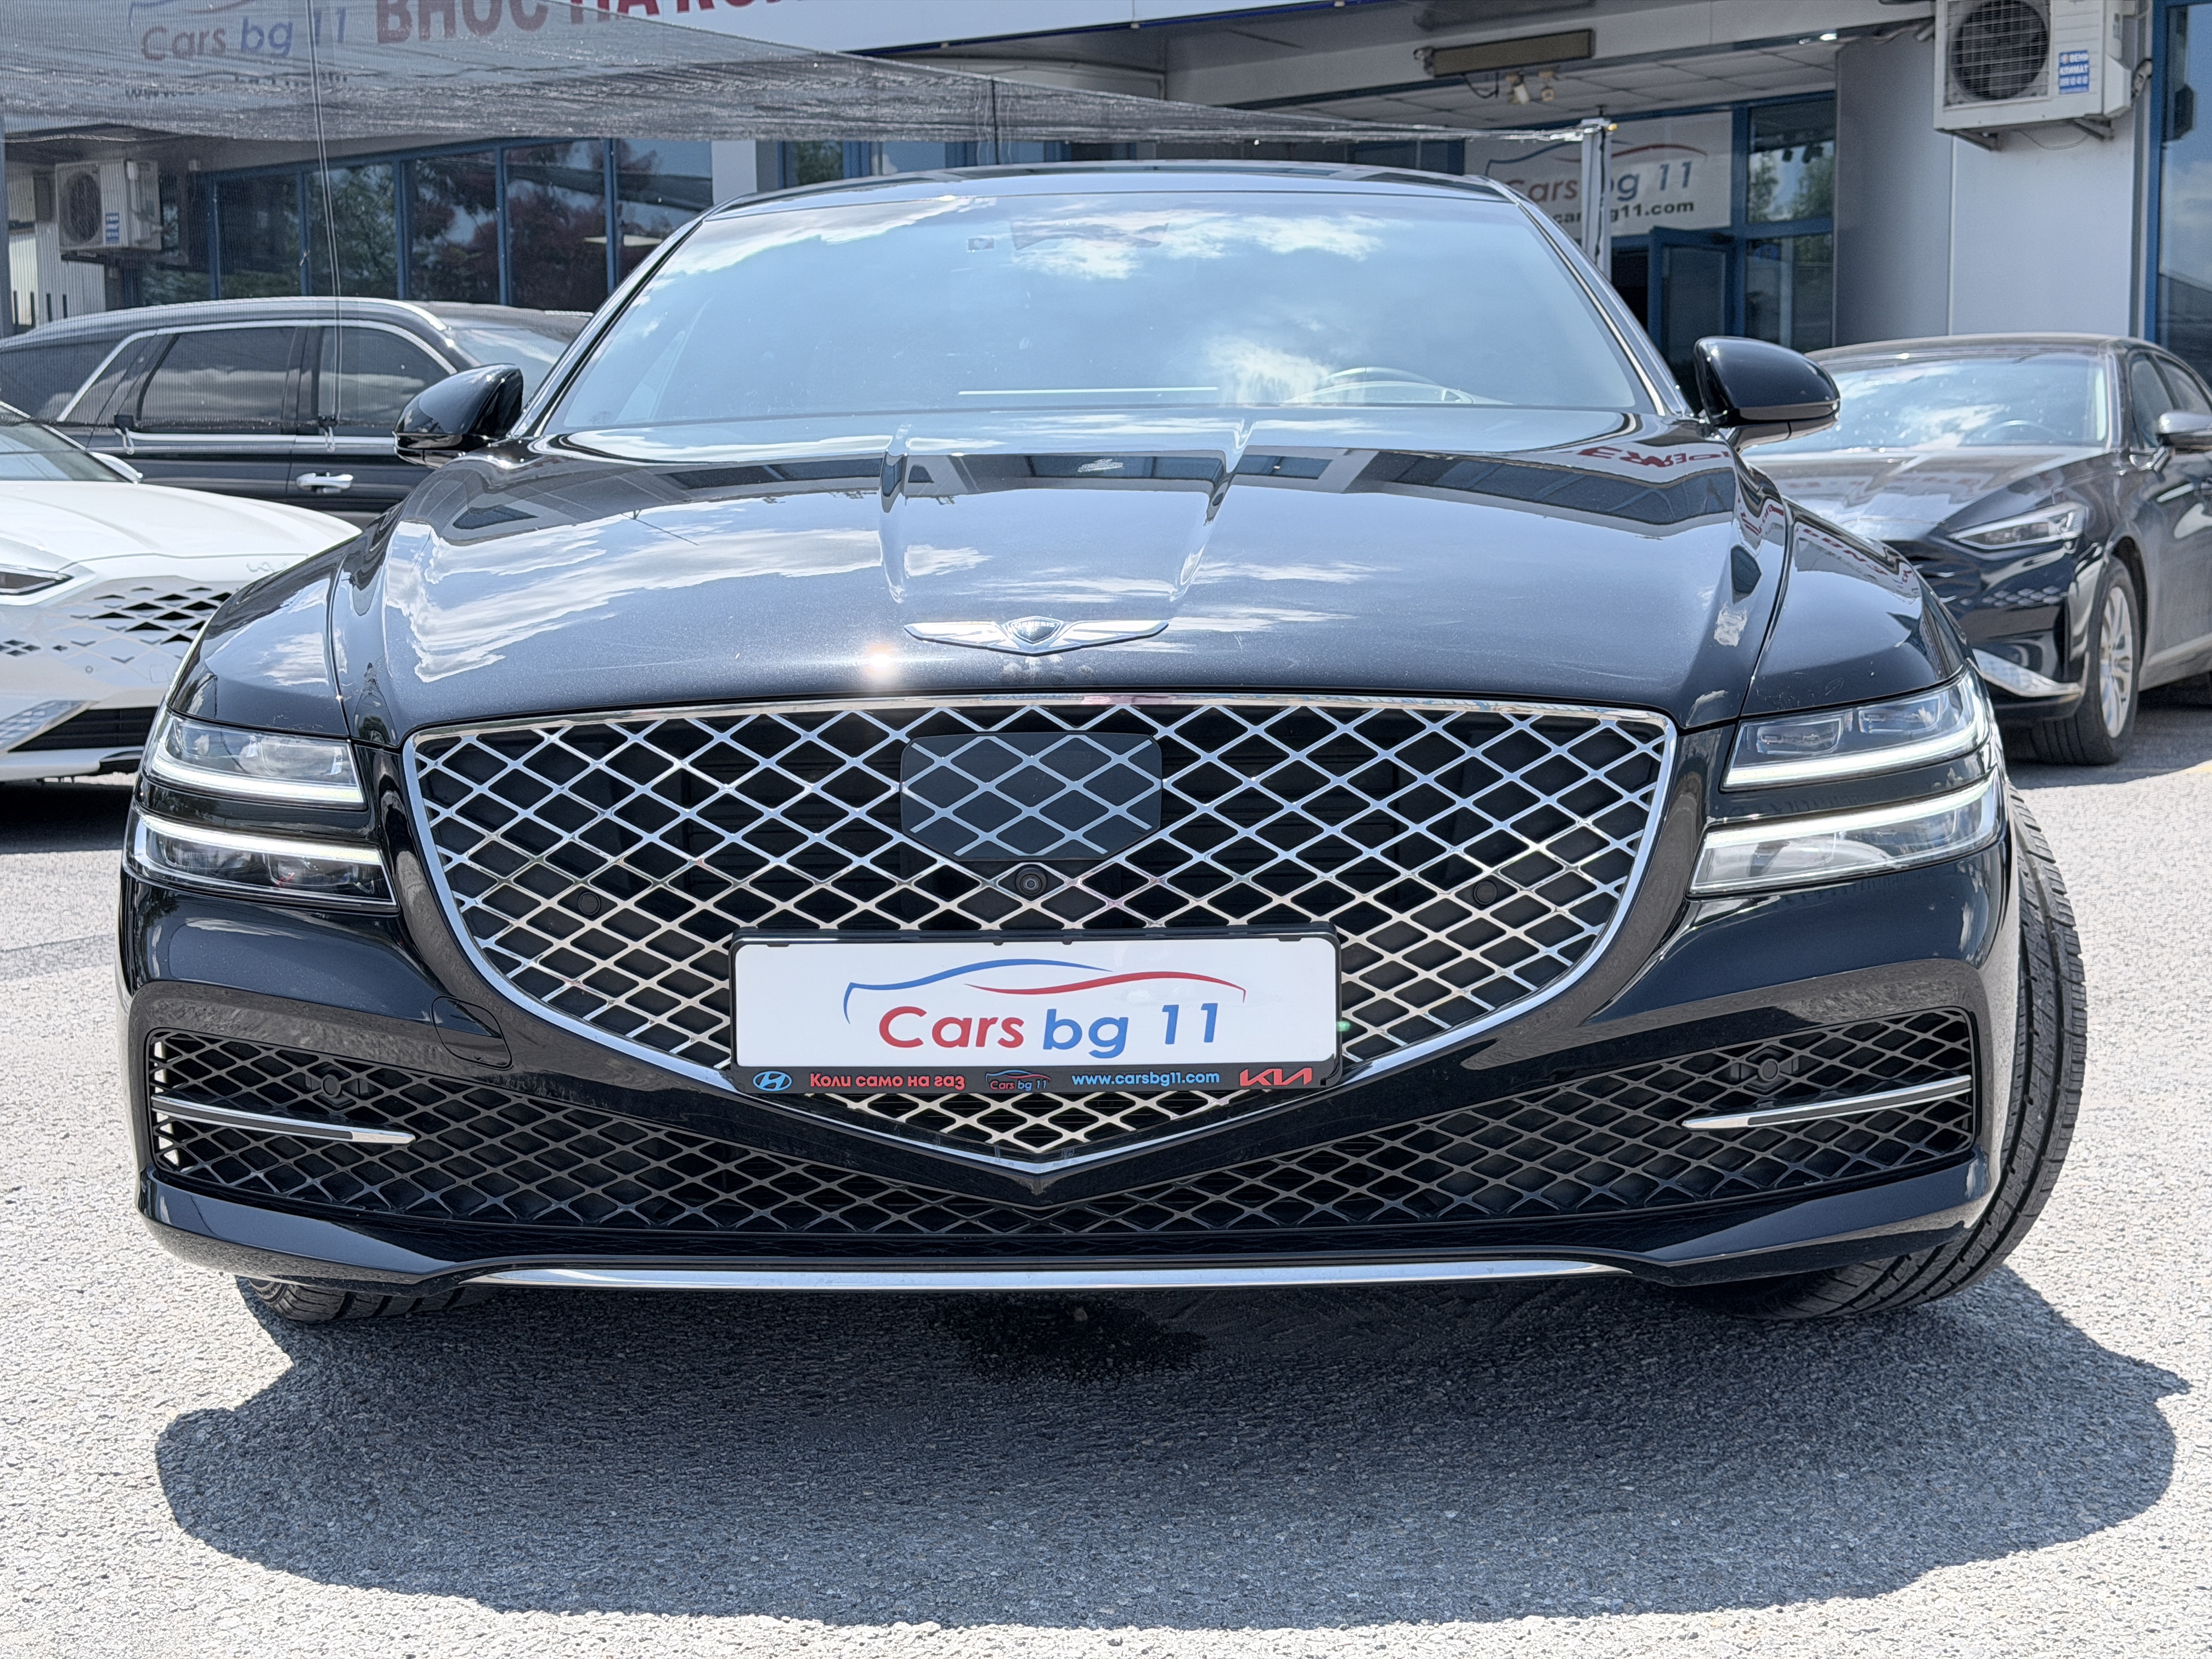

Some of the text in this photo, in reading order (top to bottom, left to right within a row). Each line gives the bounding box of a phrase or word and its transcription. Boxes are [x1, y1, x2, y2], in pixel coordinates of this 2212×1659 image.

[140, 26, 226, 61] Cars
[240, 16, 293, 58] bg
[1658, 161, 1692, 191] 11
[879, 1002, 1218, 1059] Cars bg 11
[810, 1073, 851, 1087] Коли
[855, 1075, 904, 1087] само
[907, 1075, 930, 1087] на
[990, 1079, 1047, 1091] Cars bg 11
[1071, 1071, 1220, 1087] www.carsbg11.com
